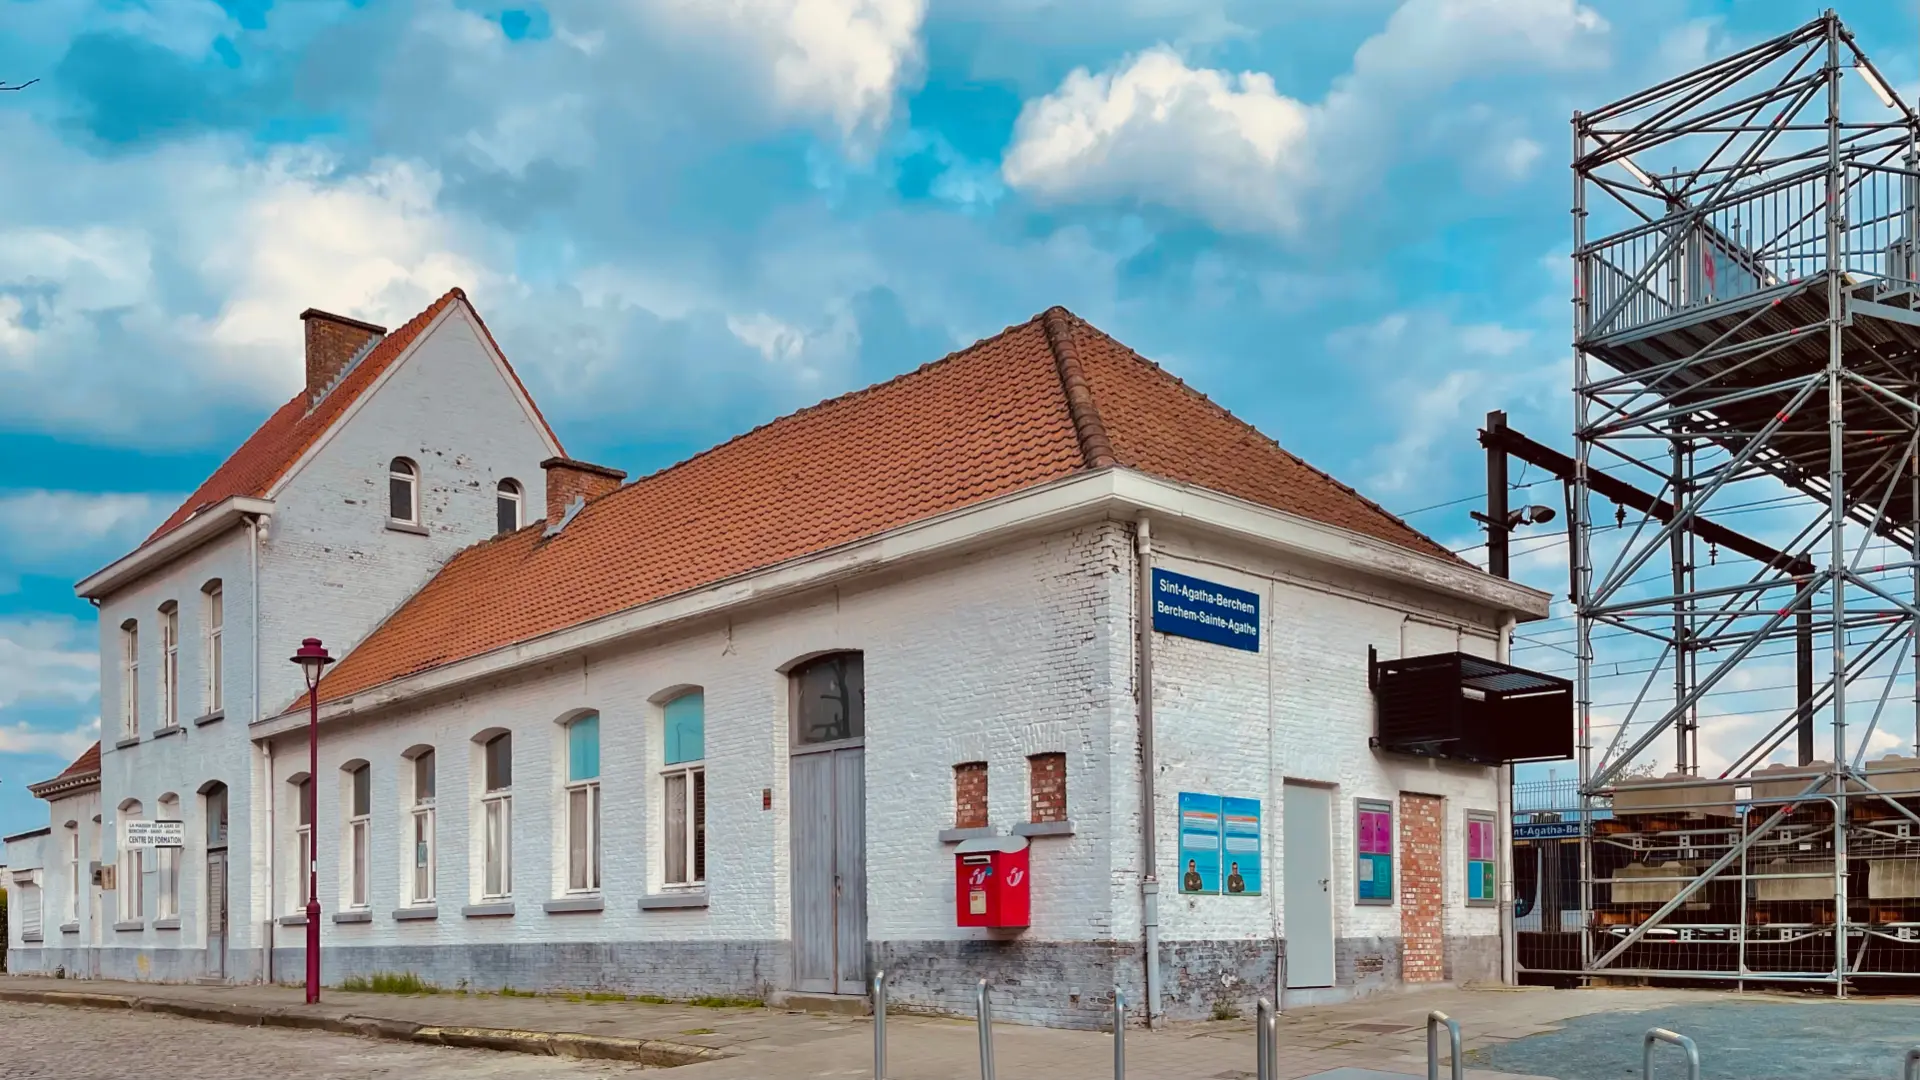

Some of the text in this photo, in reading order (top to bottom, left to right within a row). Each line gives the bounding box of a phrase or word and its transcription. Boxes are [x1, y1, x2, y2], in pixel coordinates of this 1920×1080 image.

[1160, 579, 1254, 614] Sint-Agatha-Berchem
[1158, 601, 1256, 636] Berchem-Sainte-Agathe
[129, 836, 182, 844] CENTRE DE FORMATION
